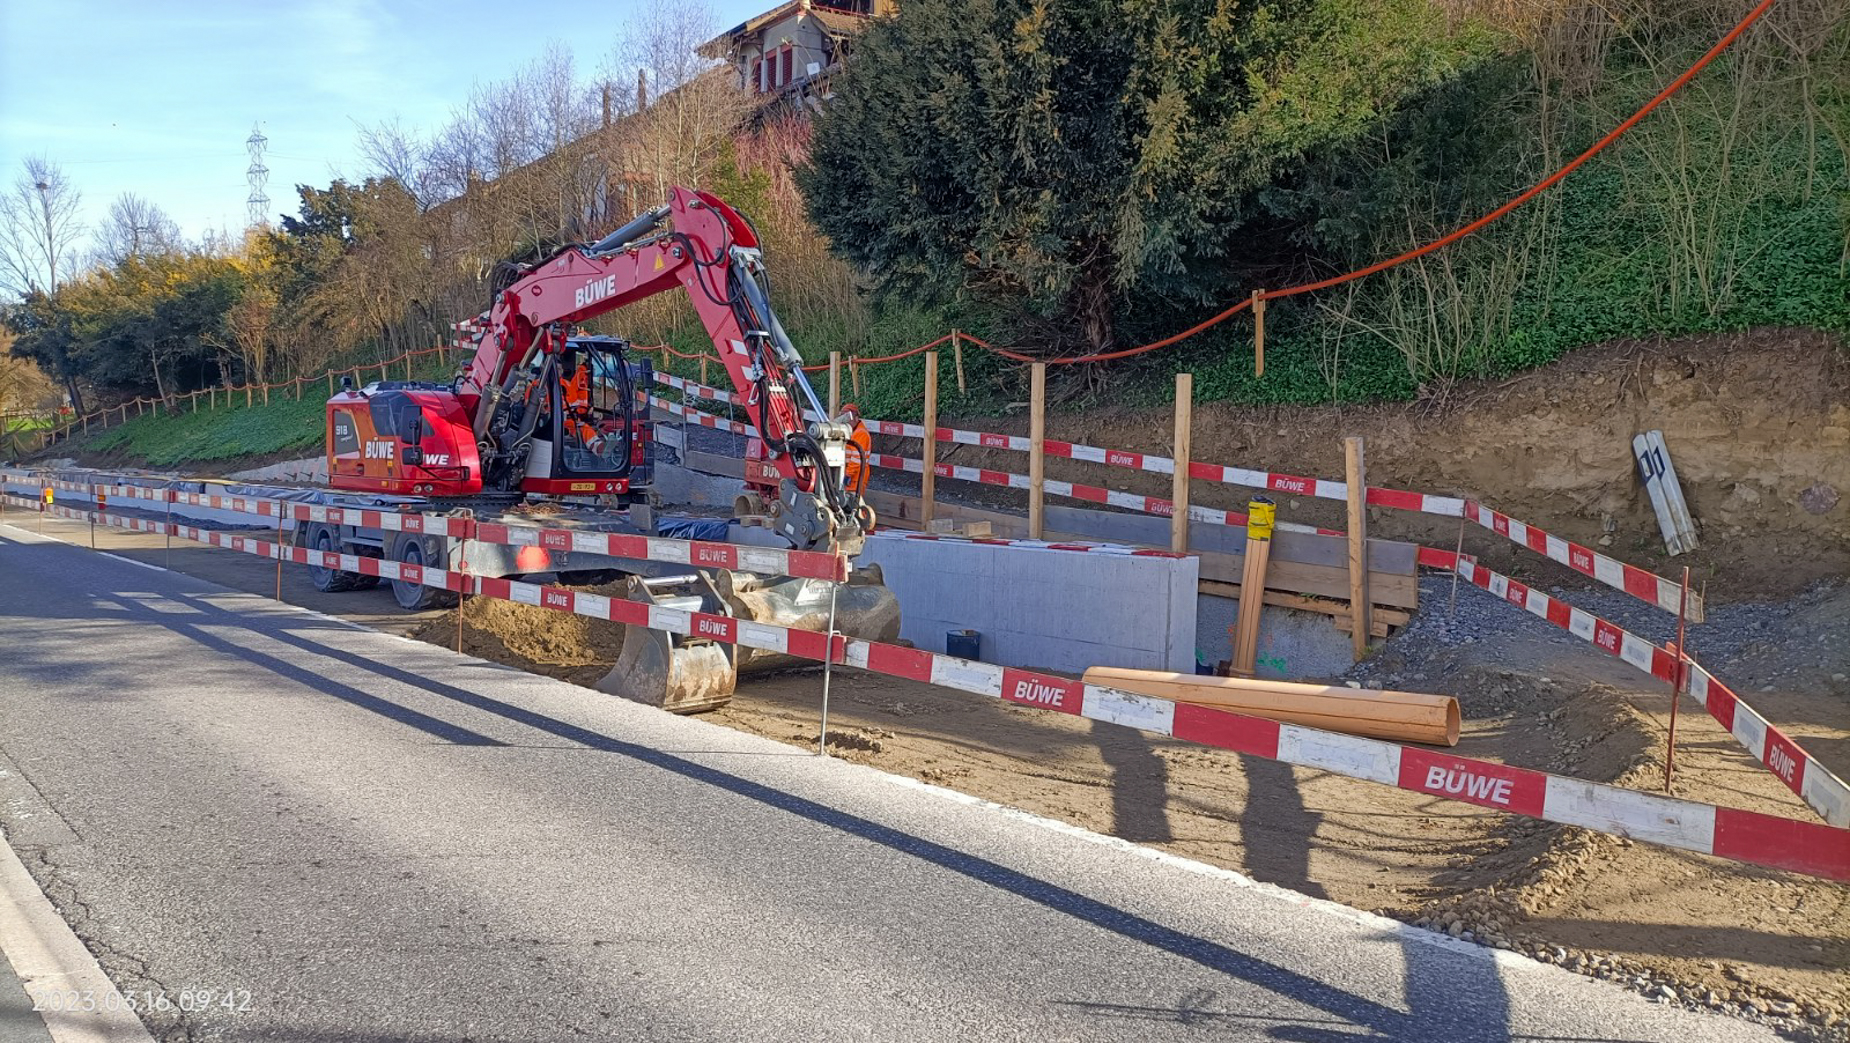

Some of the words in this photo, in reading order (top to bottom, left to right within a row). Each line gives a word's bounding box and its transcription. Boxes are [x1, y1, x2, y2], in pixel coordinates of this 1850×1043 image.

[575, 274, 616, 308] BÜWE
[364, 436, 394, 459] BÜWE
[423, 453, 449, 466] WE
[1110, 453, 1134, 466] BÜWE
[1274, 474, 1305, 493] BÜWE
[698, 546, 728, 564] BÜWE
[547, 590, 568, 607] BÜWE
[700, 618, 727, 636] BÜWE
[1597, 627, 1616, 651] BÜWE
[1014, 679, 1065, 707] BÜWE
[1768, 743, 1796, 783] BÜWE
[1424, 764, 1515, 804] BÜWE
